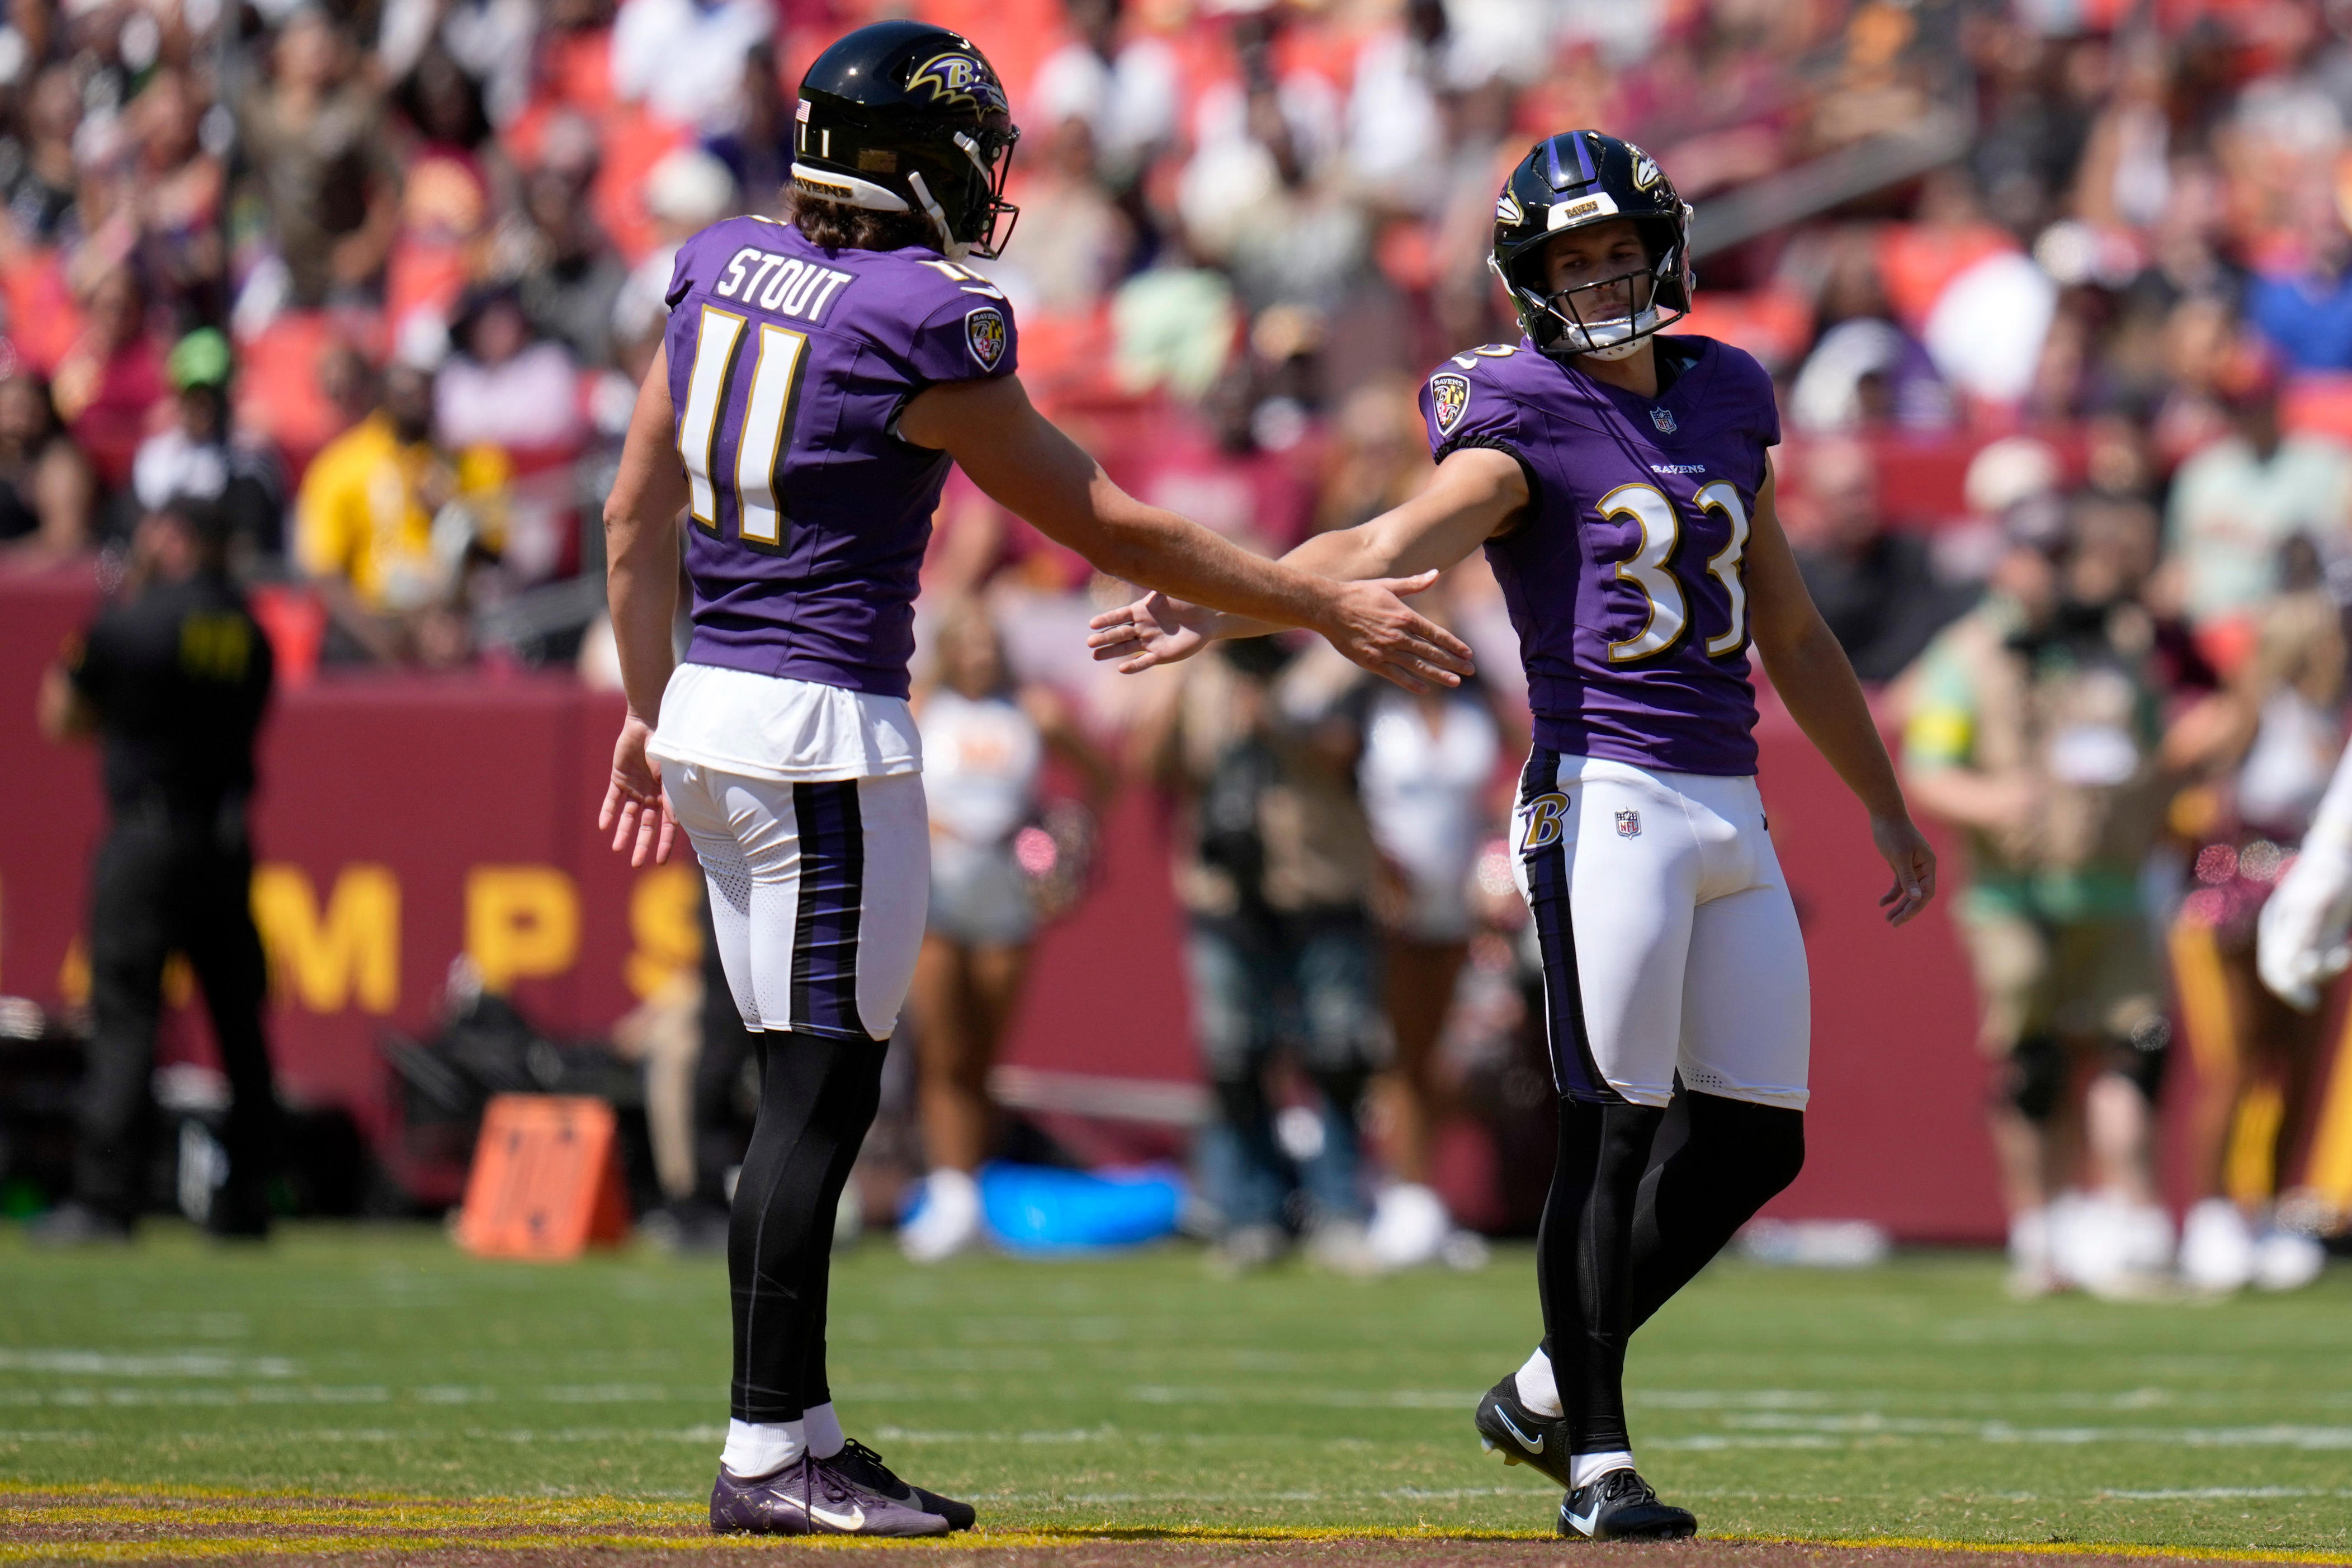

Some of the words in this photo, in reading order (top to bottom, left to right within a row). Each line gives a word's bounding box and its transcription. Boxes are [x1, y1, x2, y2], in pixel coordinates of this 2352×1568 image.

[1564, 200, 1598, 217] RAVENS
[717, 248, 852, 321] STOUT
[972, 313, 1000, 322] RAVENS
[1434, 378, 1464, 387] RAVENS
[678, 303, 810, 549] 11
[1656, 418, 1674, 430] NFL
[1650, 465, 1706, 475] RAVENS
[1595, 479, 1751, 662] 33
[1518, 791, 1571, 856] B
[1619, 821, 1638, 833] NFL
